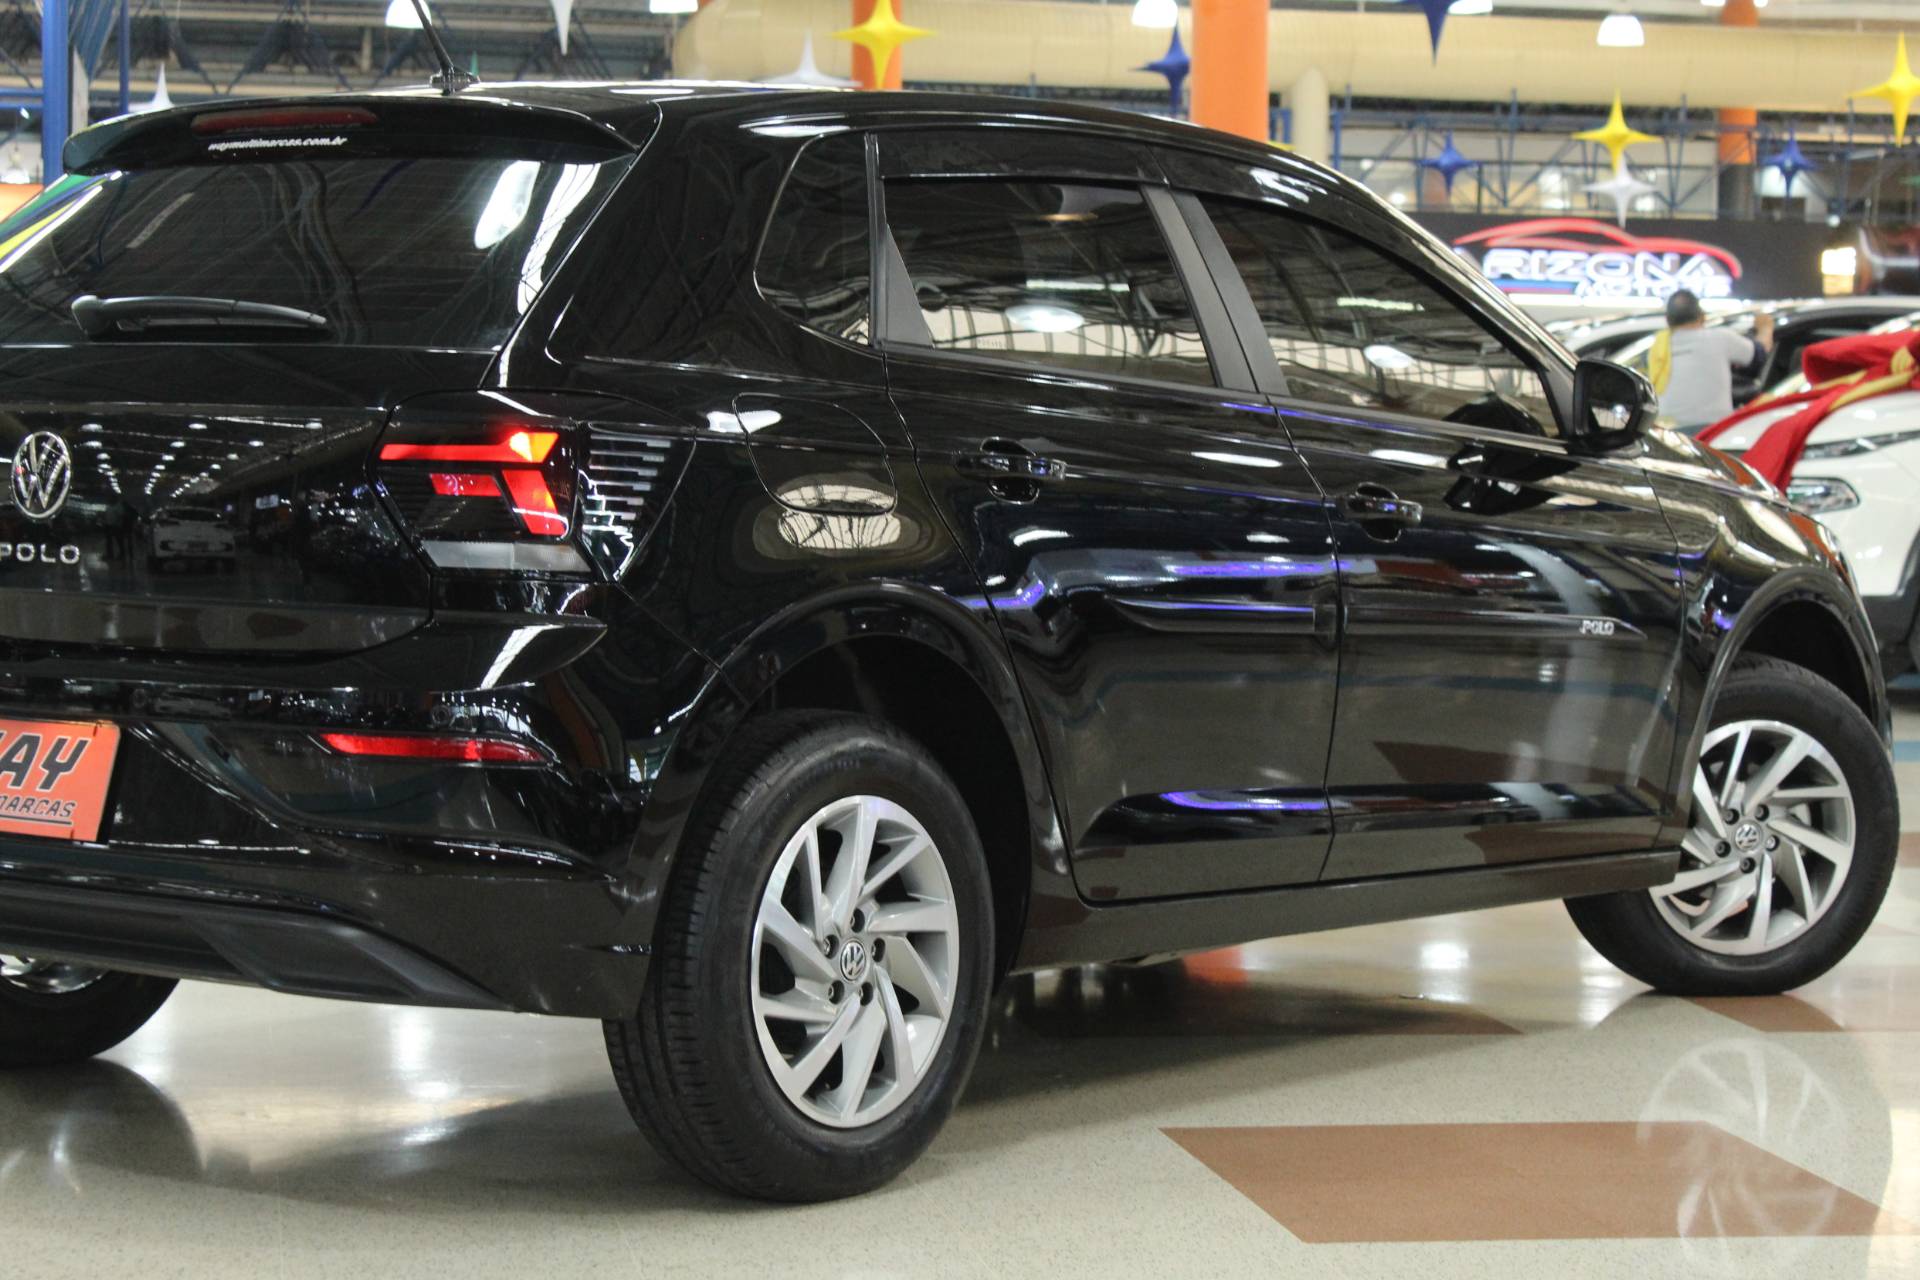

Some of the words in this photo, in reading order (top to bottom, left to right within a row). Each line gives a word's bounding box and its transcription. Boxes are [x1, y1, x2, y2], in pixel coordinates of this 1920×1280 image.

[1454, 248, 1717, 284] RIZONA
[0, 543, 80, 564] POLO
[1580, 619, 1615, 636] POLO
[0, 731, 92, 793] AY
